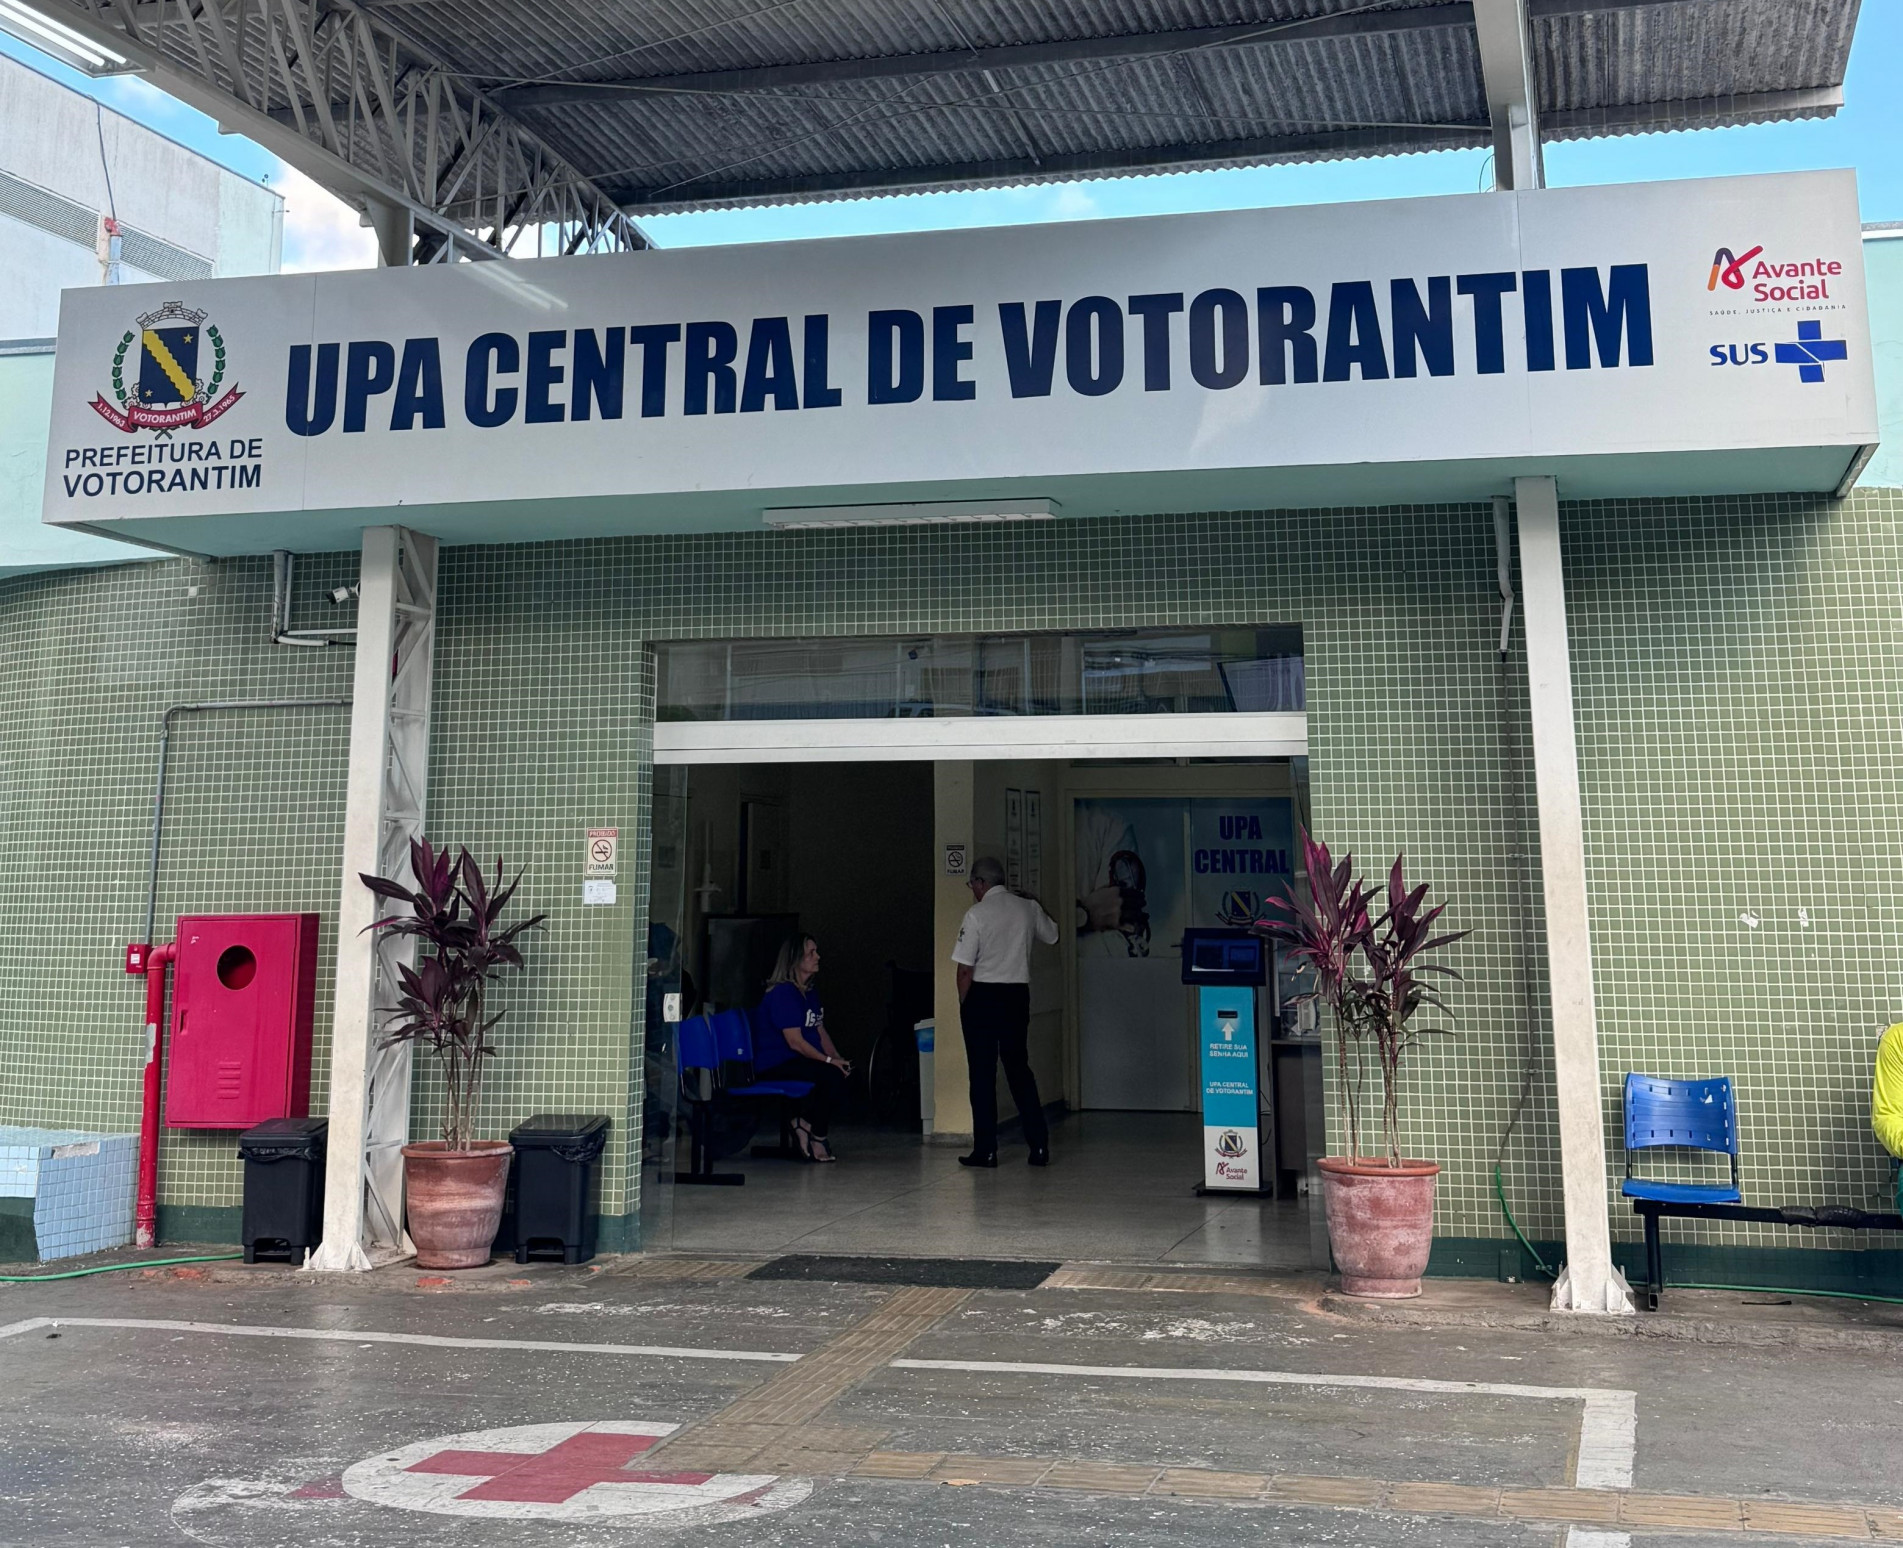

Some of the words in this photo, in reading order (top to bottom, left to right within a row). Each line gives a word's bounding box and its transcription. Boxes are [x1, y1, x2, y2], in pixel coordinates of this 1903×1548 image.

[1752, 258, 1842, 279] Avante
[1753, 279, 1830, 302] Social
[1746, 307, 1782, 315] JUSTIÇA
[1796, 304, 1847, 312] CIDADANIA
[285, 336, 446, 437] UPA
[464, 314, 842, 428] CENTRAL
[867, 304, 977, 405] DE
[998, 263, 1655, 399] VOTORANTIM
[1709, 342, 1769, 366] SUS
[133, 408, 197, 424] VOTORANTIM
[65, 440, 222, 469] PREFEITURA
[229, 438, 263, 460] DE
[63, 464, 262, 498] VOTORANTIM
[1219, 815, 1263, 840] UPA
[1194, 849, 1290, 874] CENTRAL
[1226, 1173, 1244, 1181] Social
